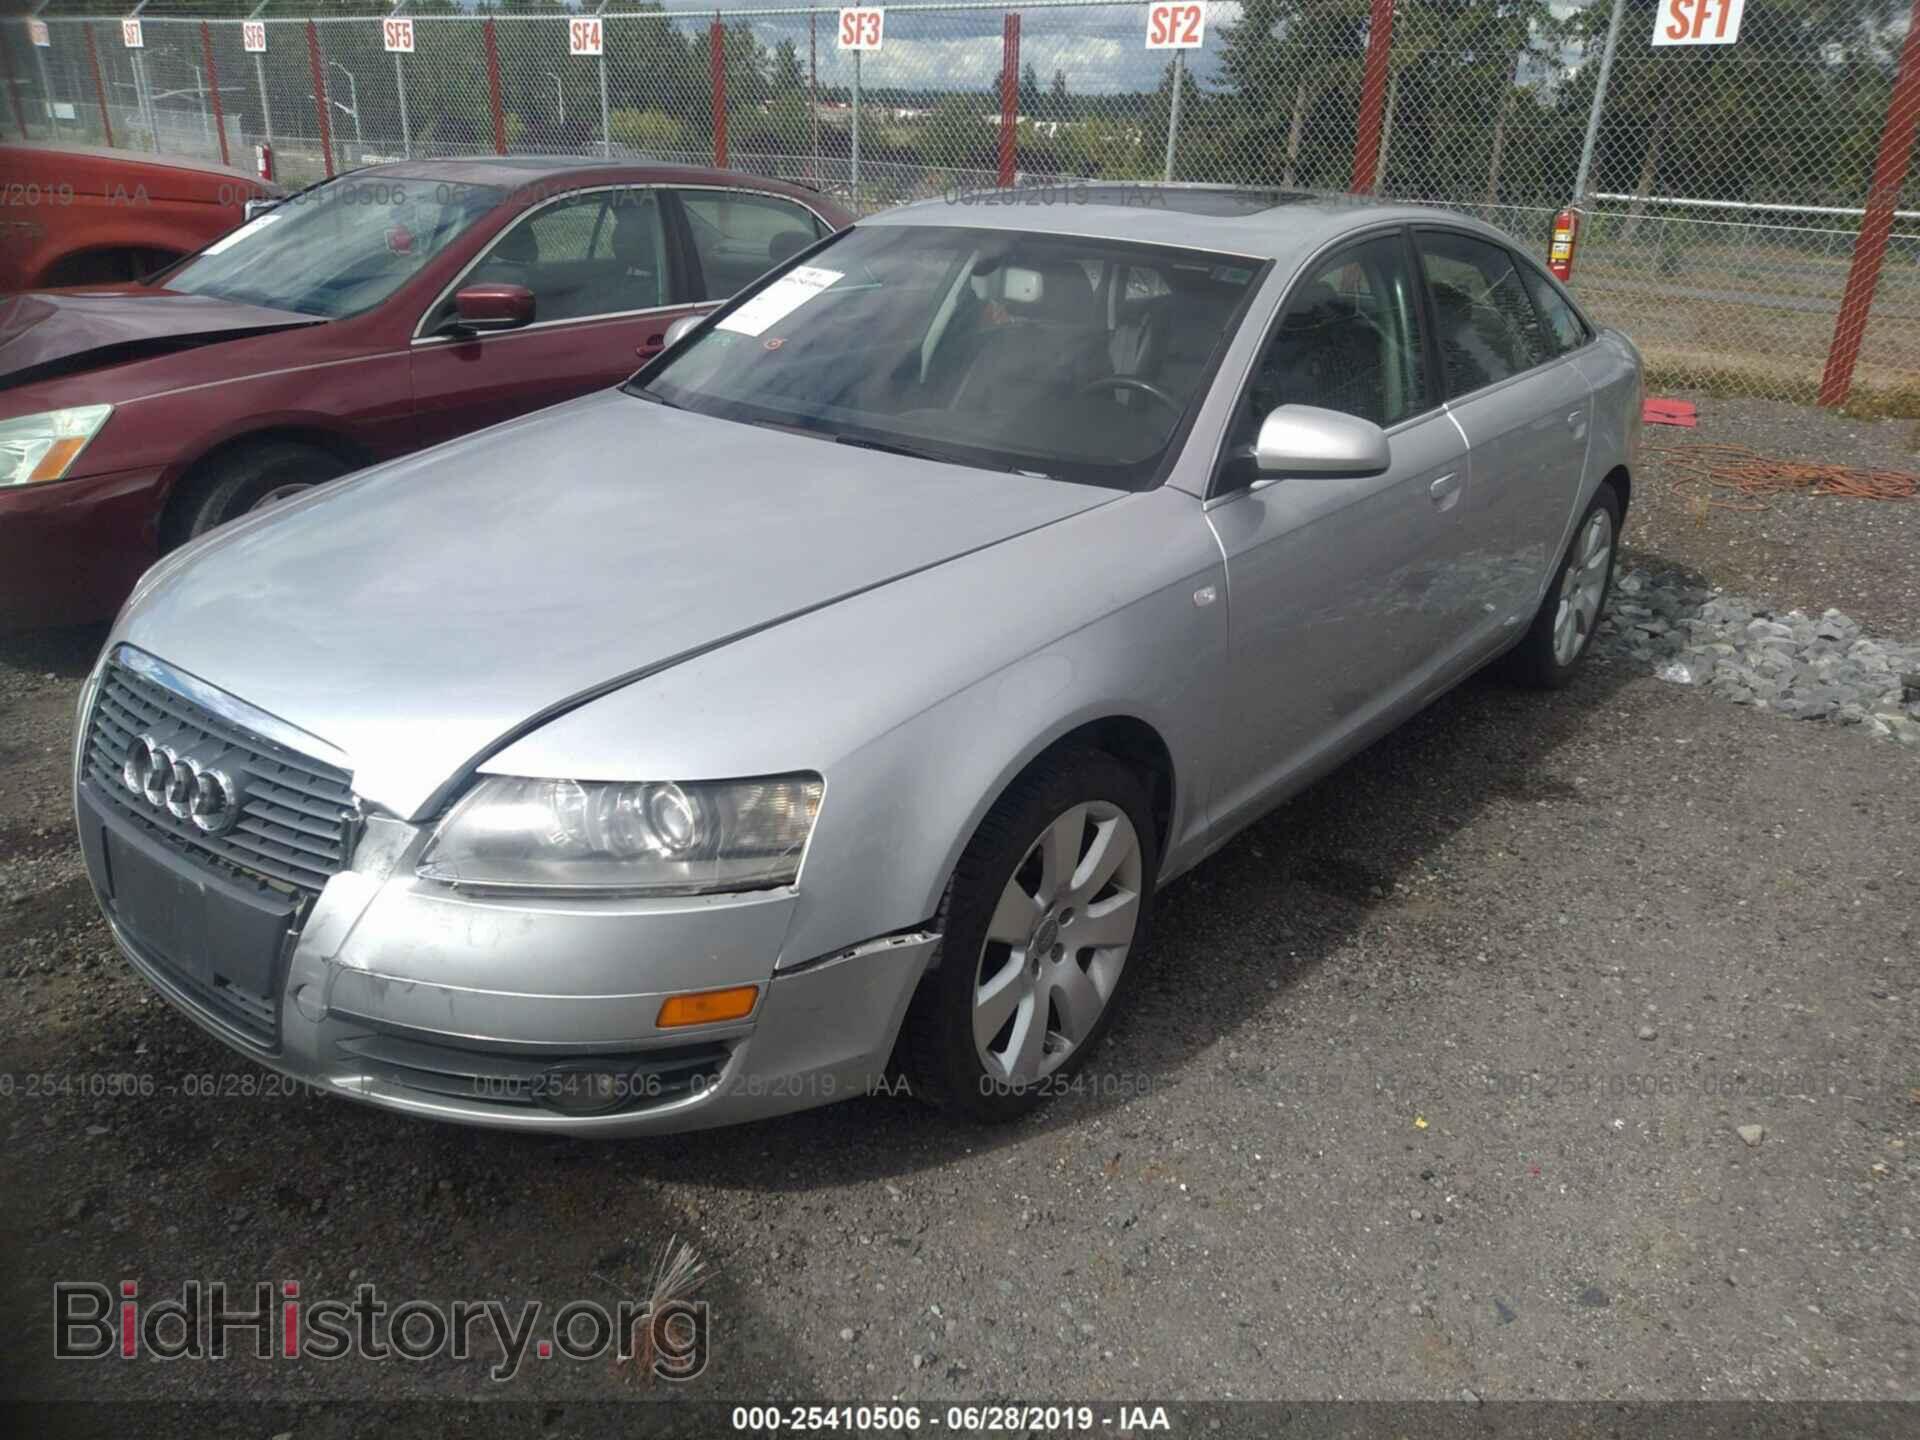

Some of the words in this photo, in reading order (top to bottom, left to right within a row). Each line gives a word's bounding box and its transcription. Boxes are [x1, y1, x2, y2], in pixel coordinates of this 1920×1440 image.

[386, 22, 412, 48] SF5
[841, 12, 881, 46] SF3
[1150, 7, 1202, 45] SF2
[1665, 0, 1731, 40] SF1
[245, 25, 264, 49] SF6
[572, 22, 601, 51] SF4
